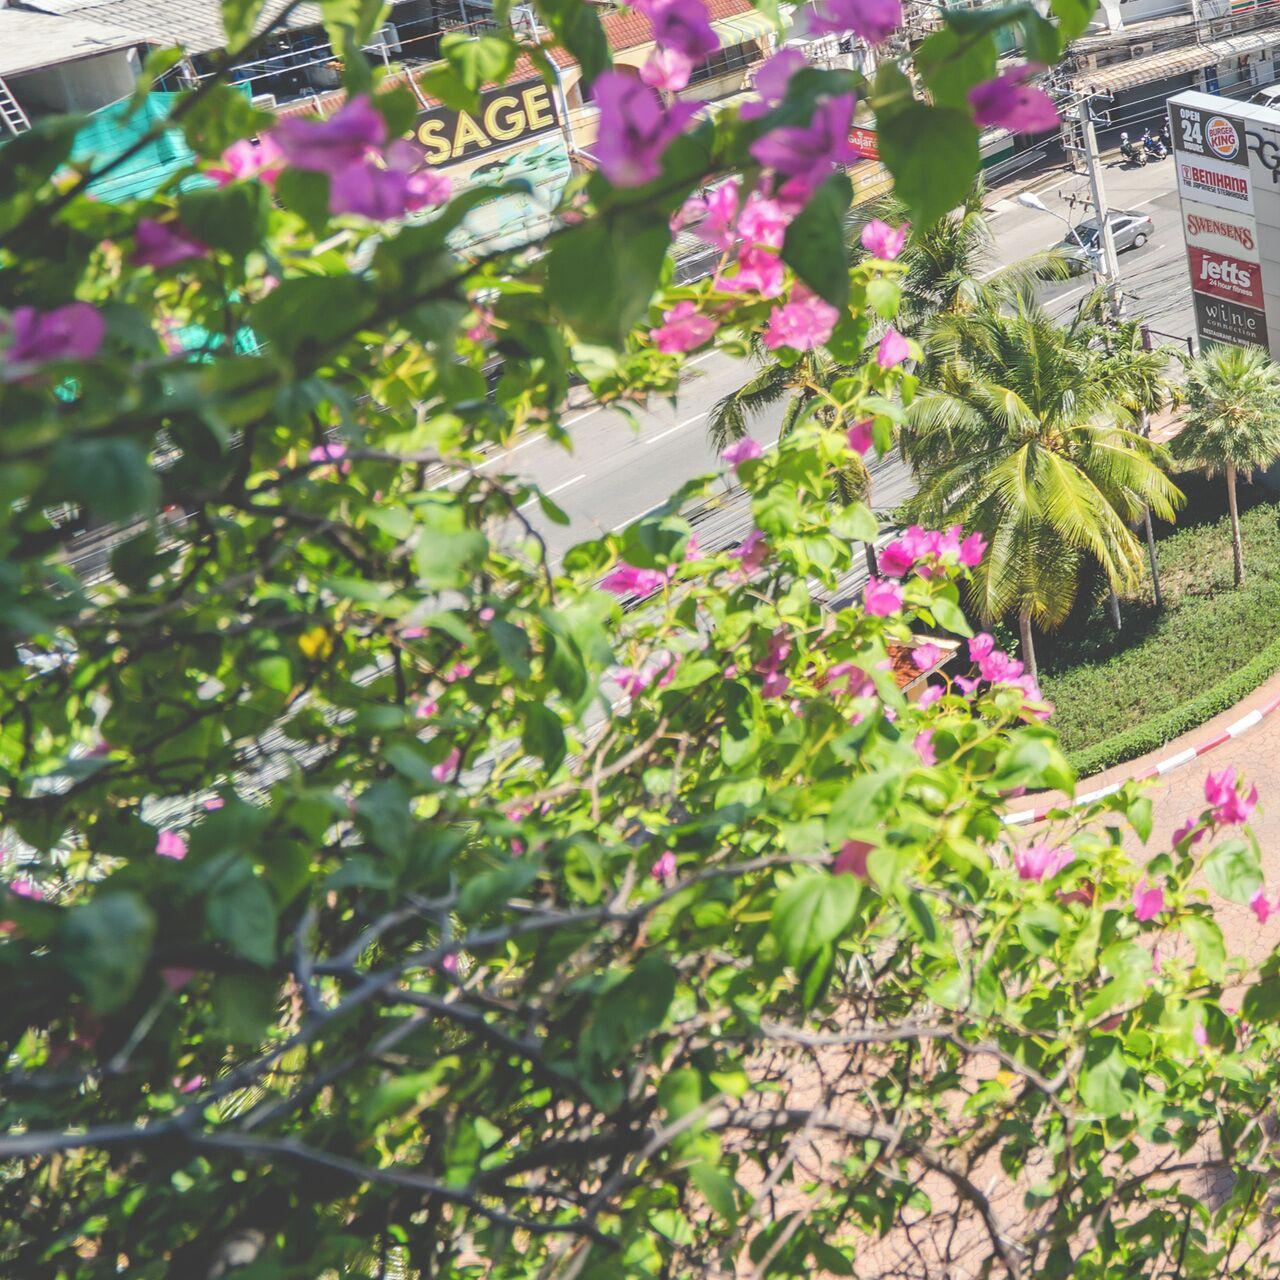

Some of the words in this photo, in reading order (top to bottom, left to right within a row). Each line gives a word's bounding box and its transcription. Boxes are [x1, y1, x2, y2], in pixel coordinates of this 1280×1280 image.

[1180, 108, 1200, 121] OPEN
[1181, 120, 1203, 144] 24
[1209, 126, 1233, 137] BURGER
[1210, 135, 1236, 148] KING
[1183, 179, 1192, 187] THE
[1193, 181, 1217, 194] JAPANESE
[1217, 187, 1249, 201] STEAKHOUSE
[1192, 166, 1249, 195] BENIHANA
[1200, 254, 1251, 288] jetts
[1209, 278, 1217, 286] 24
[1218, 281, 1232, 290] hour
[1233, 285, 1253, 297] fitness
[1202, 327, 1232, 341] RESTAURANT
[1207, 319, 1257, 339] connection
